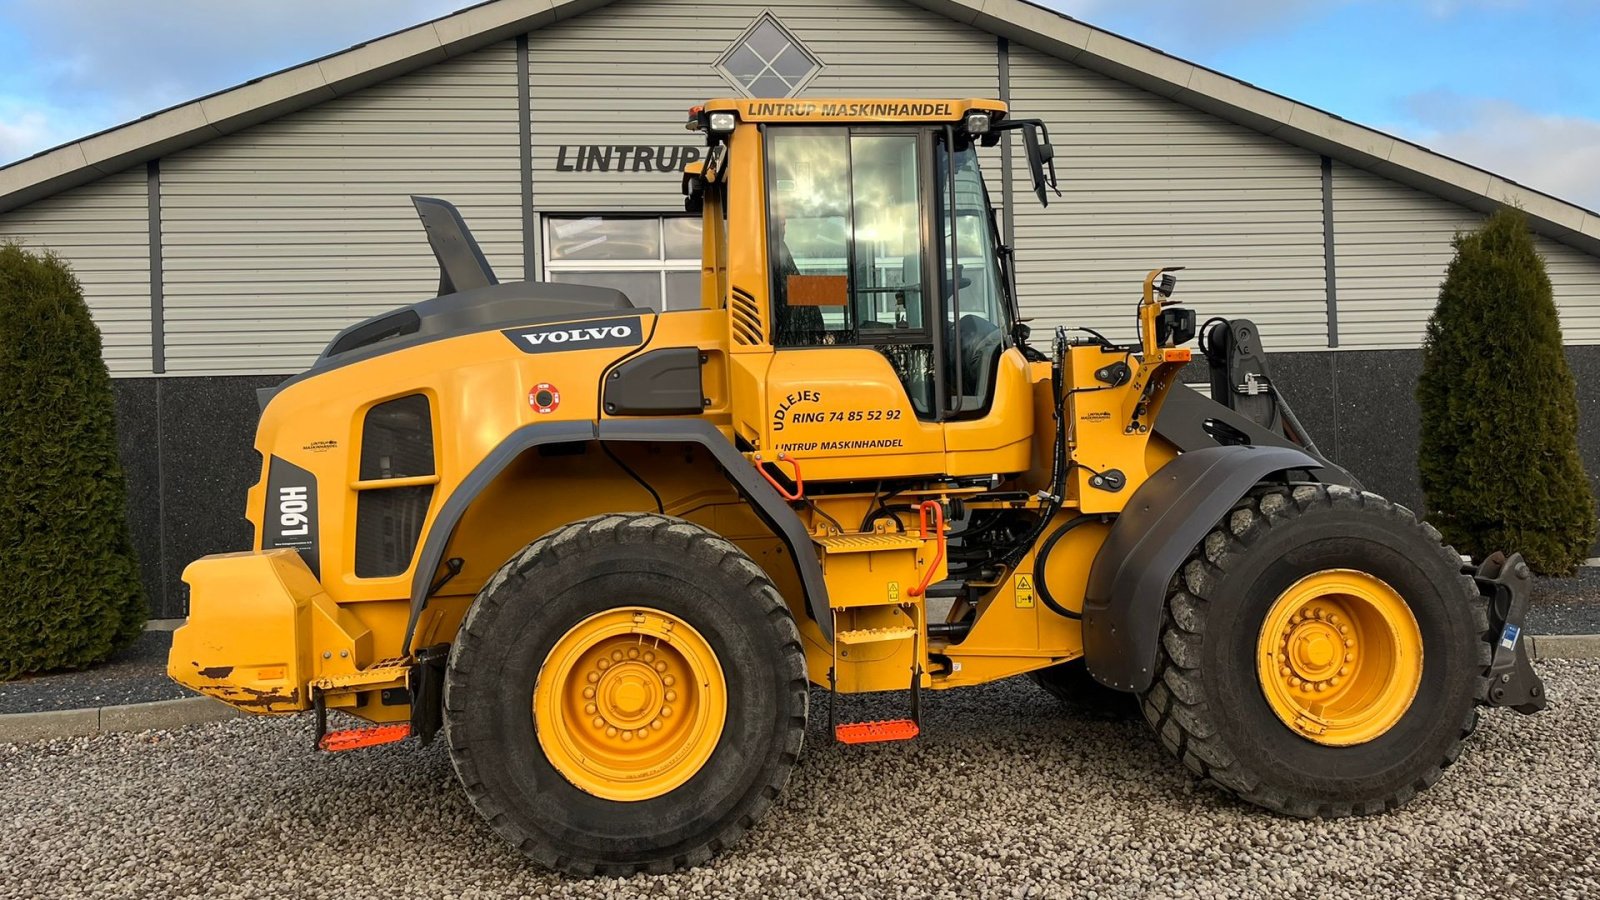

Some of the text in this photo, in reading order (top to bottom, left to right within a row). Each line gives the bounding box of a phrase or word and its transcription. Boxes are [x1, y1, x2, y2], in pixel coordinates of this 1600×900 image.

[748, 103, 953, 116] LINTRUP MASKINHANDEL
[555, 145, 701, 172] LINTRUP
[521, 325, 632, 345] VOLVO
[773, 390, 821, 431] UDLEJES
[792, 409, 901, 423] RING 74 85 52 92
[820, 439, 903, 450] MASKINHANDEL
[280, 486, 308, 536] L90H
